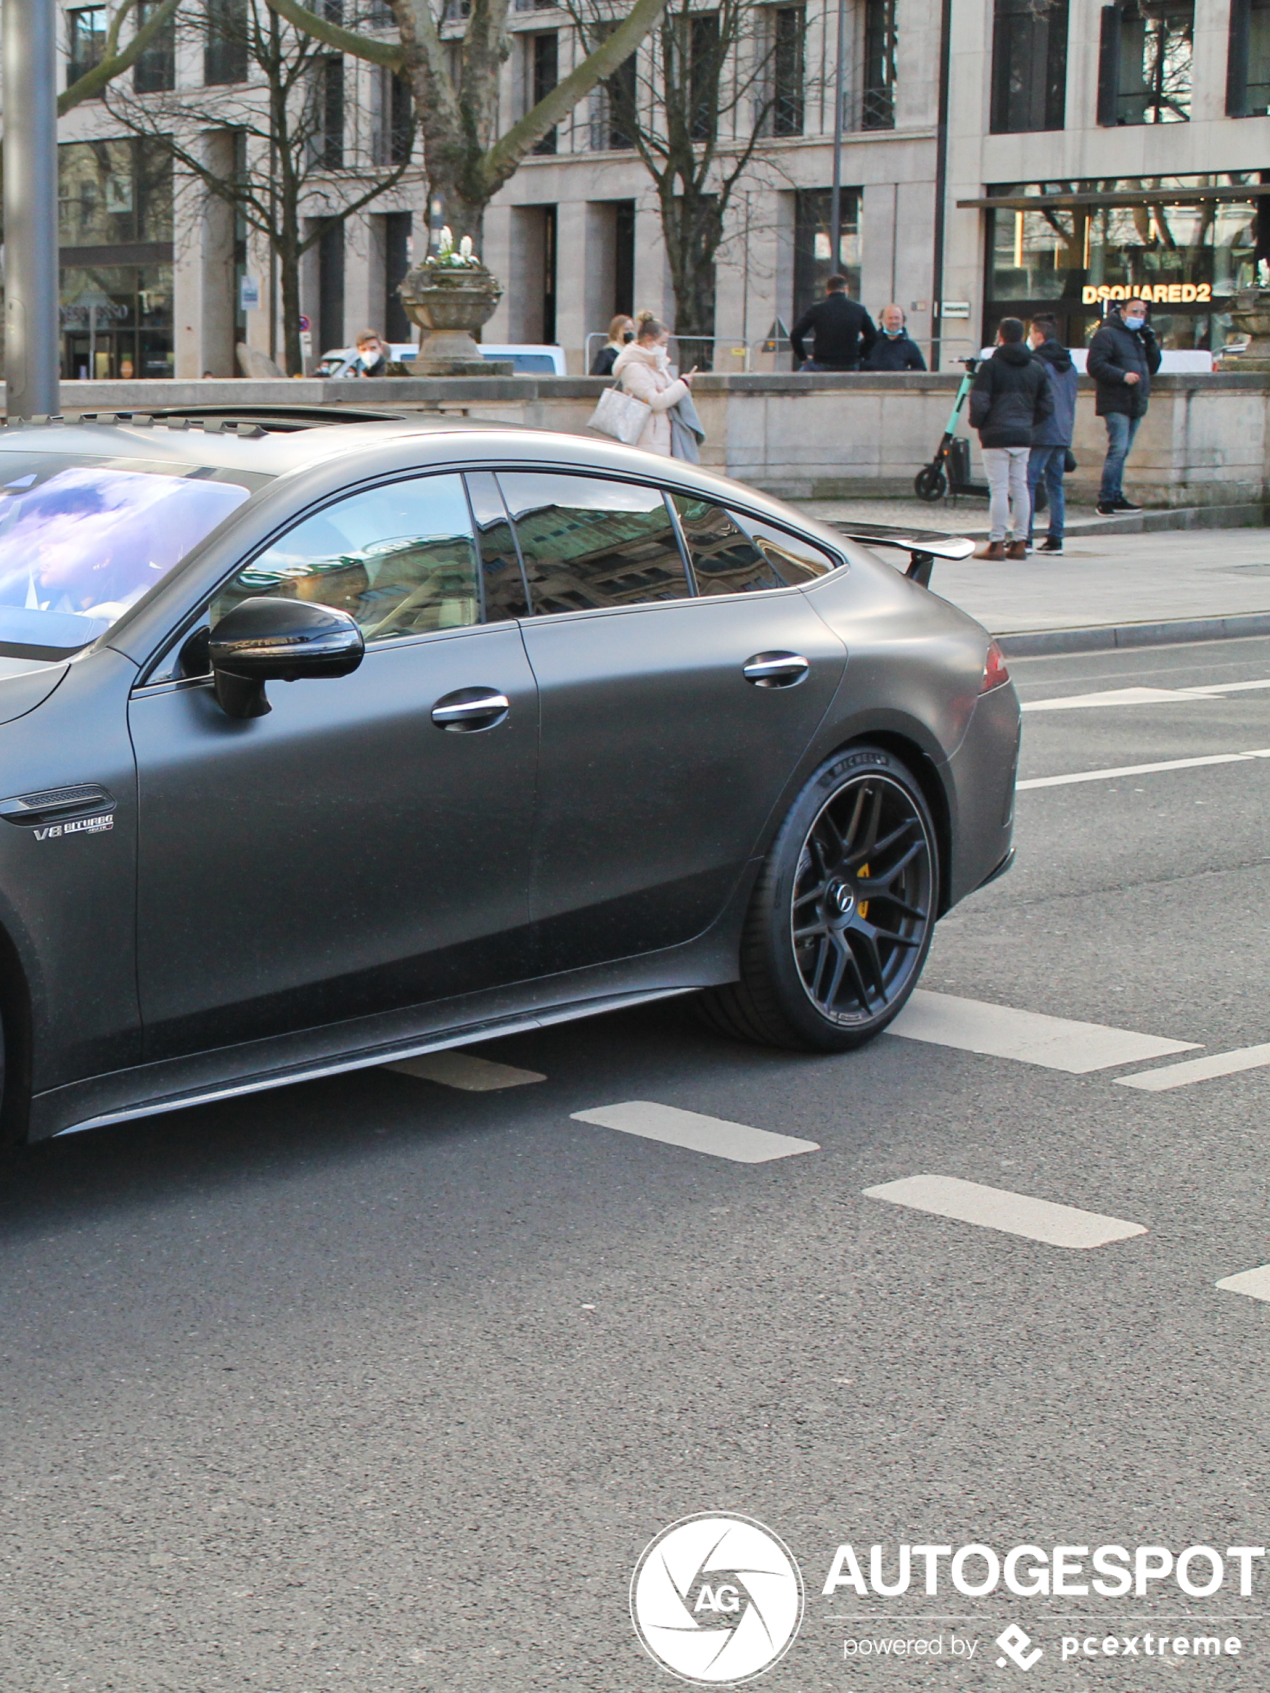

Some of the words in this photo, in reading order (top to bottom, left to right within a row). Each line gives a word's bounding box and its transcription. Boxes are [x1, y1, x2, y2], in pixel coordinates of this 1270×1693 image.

[1082, 283, 1211, 304] DSQUARED2
[33, 825, 62, 841] V8
[64, 815, 113, 832] BITURBO
